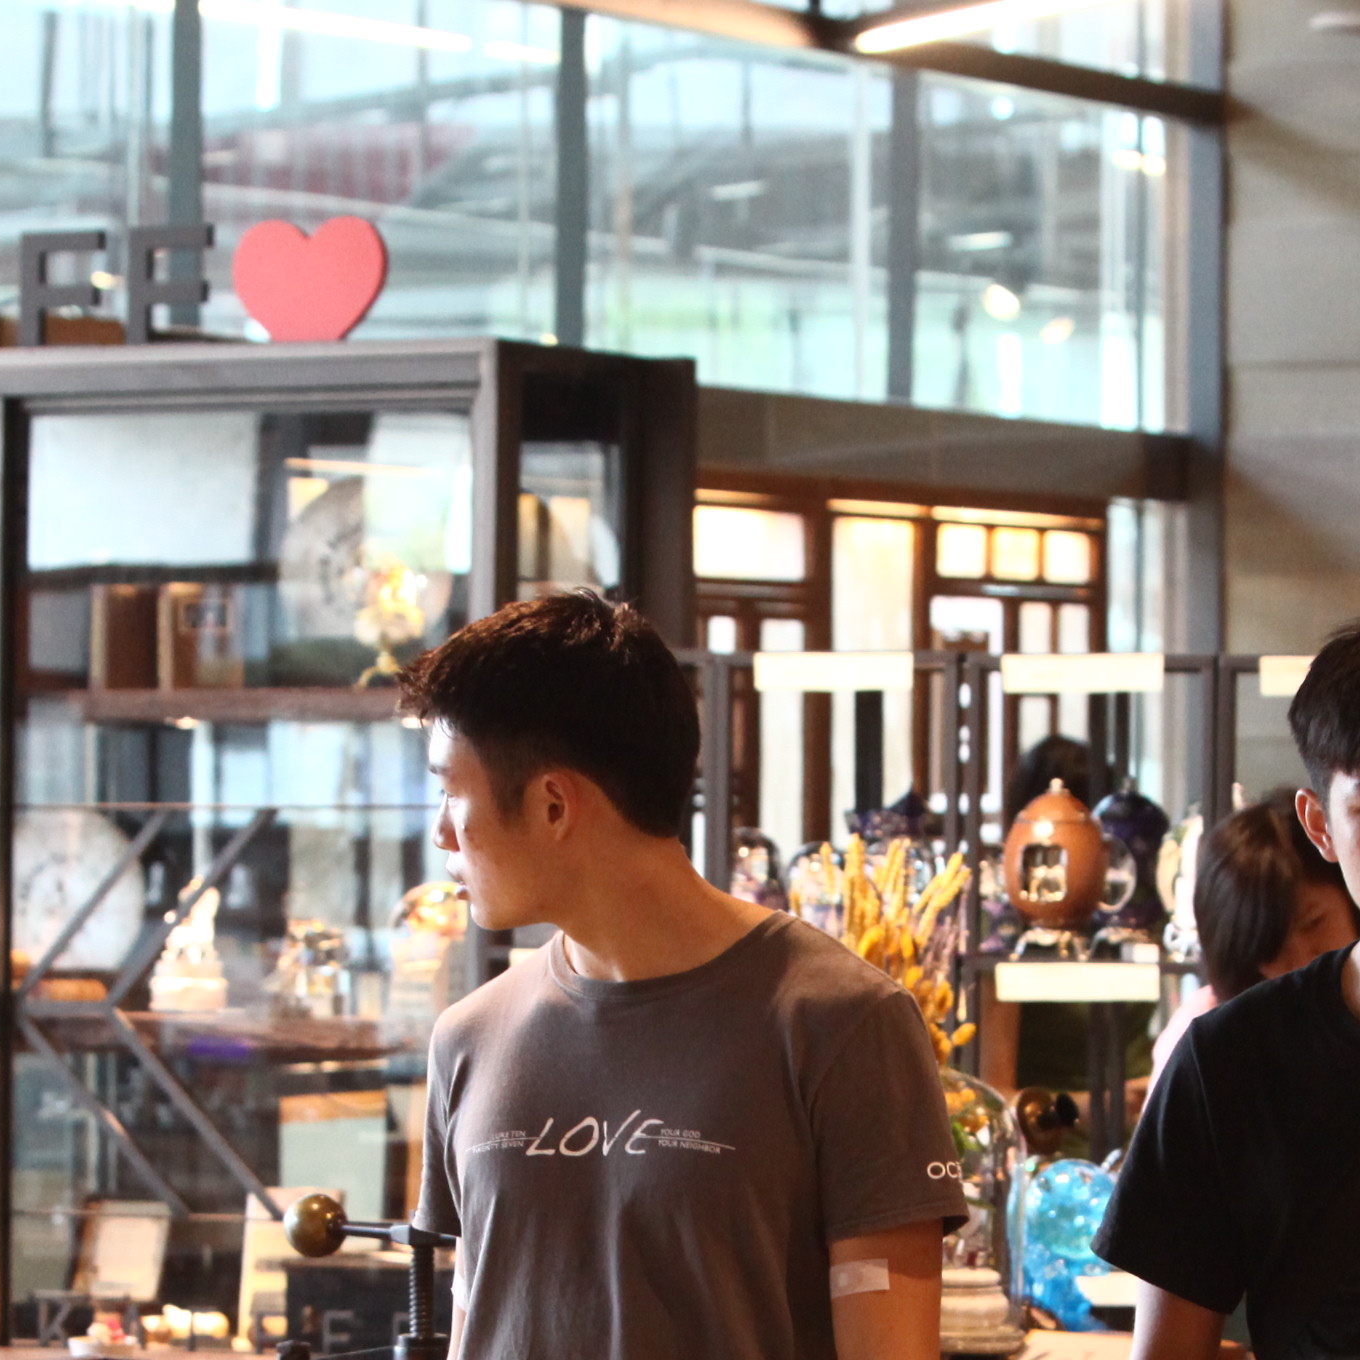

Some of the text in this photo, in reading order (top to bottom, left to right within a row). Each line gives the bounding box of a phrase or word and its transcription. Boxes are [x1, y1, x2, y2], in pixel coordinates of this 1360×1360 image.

[511, 1130, 526, 1138] TEN
[525, 1109, 664, 1157] LOVE
[660, 1129, 701, 1139] YOUR GOD
[500, 1140, 524, 1149] SEVEN
[658, 1139, 678, 1148] YOUR
